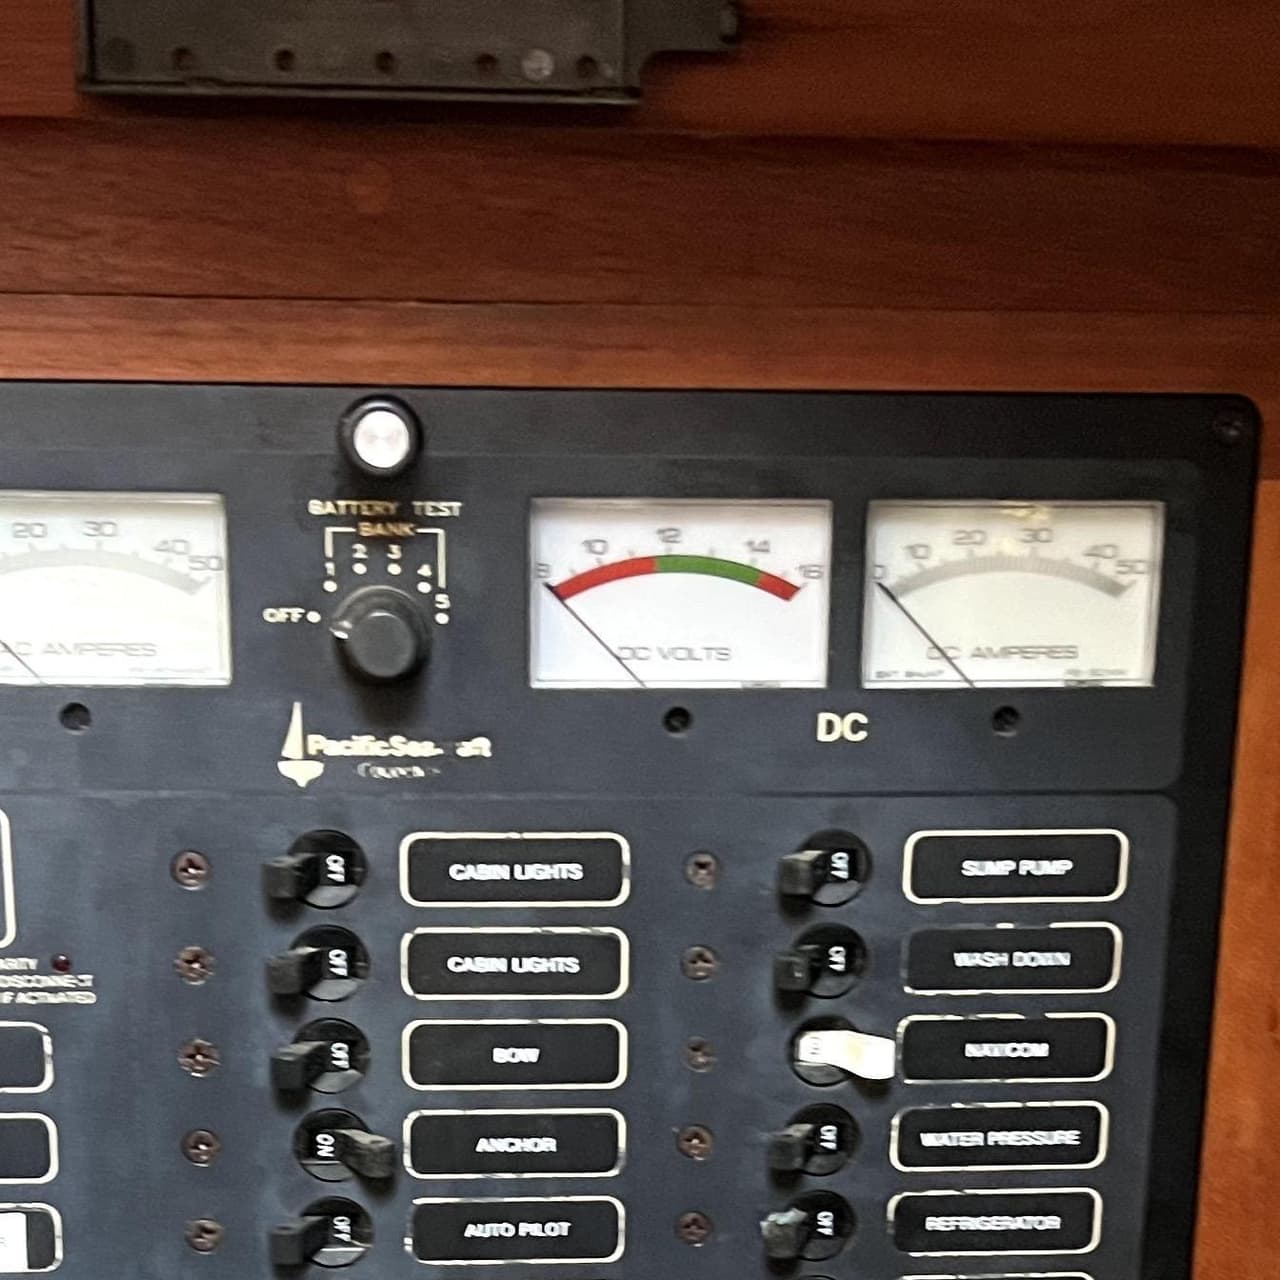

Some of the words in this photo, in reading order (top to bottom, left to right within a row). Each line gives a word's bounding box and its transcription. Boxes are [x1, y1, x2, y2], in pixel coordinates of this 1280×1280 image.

[308, 500, 401, 516] BATTERY
[412, 501, 463, 517] TEST
[11, 521, 47, 539] 20
[83, 520, 118, 537] 30
[356, 523, 417, 537] BANK
[656, 527, 683, 544] 12
[1019, 528, 1053, 544] 30
[952, 529, 987, 546] 20
[153, 538, 189, 555] 40
[352, 543, 368, 559] 2
[387, 543, 402, 559] 3
[583, 538, 609, 556] 10
[747, 539, 771, 555] 14
[904, 543, 931, 560] 10
[1084, 543, 1118, 560] 40
[188, 555, 225, 572] 50
[325, 561, 336, 577] 1
[417, 564, 432, 577] 4
[1115, 558, 1148, 575] 50
[435, 593, 451, 610] 5
[262, 607, 305, 623] OFF
[42, 641, 158, 657] AMPERES
[618, 646, 652, 661] DC
[658, 646, 733, 662] VOLTS
[969, 644, 1080, 660] AMPERES
[816, 712, 869, 742] DC
[448, 863, 510, 881] CABIN
[514, 862, 584, 880] LIGHTS
[961, 860, 1017, 877] SUMP
[1019, 859, 1074, 877] PUMP
[446, 957, 508, 974] CABIN
[511, 957, 581, 974] LIGHTS
[953, 951, 1009, 968] WASH
[1013, 951, 1071, 968] DOWN
[491, 1047, 540, 1063] BOW
[475, 1137, 557, 1153] ANCHOR
[920, 1131, 984, 1147] WATER
[987, 1129, 1081, 1147] PRESSURE
[464, 1222, 516, 1238] AUTO
[518, 1221, 572, 1238] PILOT
[924, 1215, 1062, 1232] REFRIGERATOR
